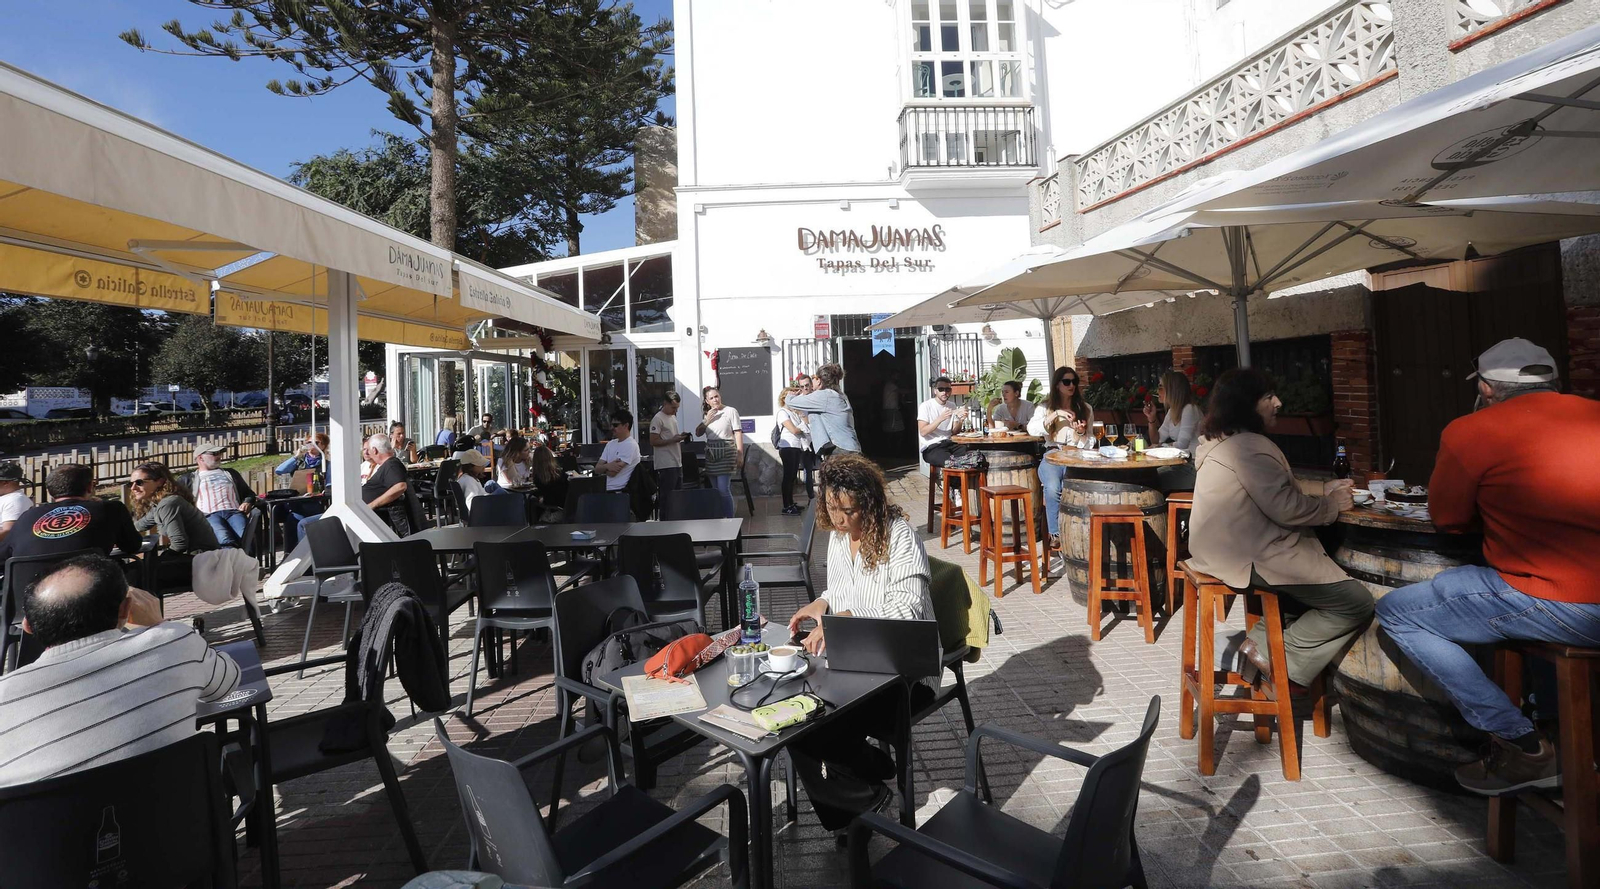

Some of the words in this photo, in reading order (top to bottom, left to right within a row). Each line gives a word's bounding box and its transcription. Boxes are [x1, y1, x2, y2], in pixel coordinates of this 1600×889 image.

[797, 224, 944, 251] DAMAJUANAS
[816, 257, 862, 271] Tapas
[870, 257, 896, 268] Del
[903, 257, 932, 268] Sur
[469, 285, 489, 302] Estrella
[489, 291, 506, 307] Galicia
